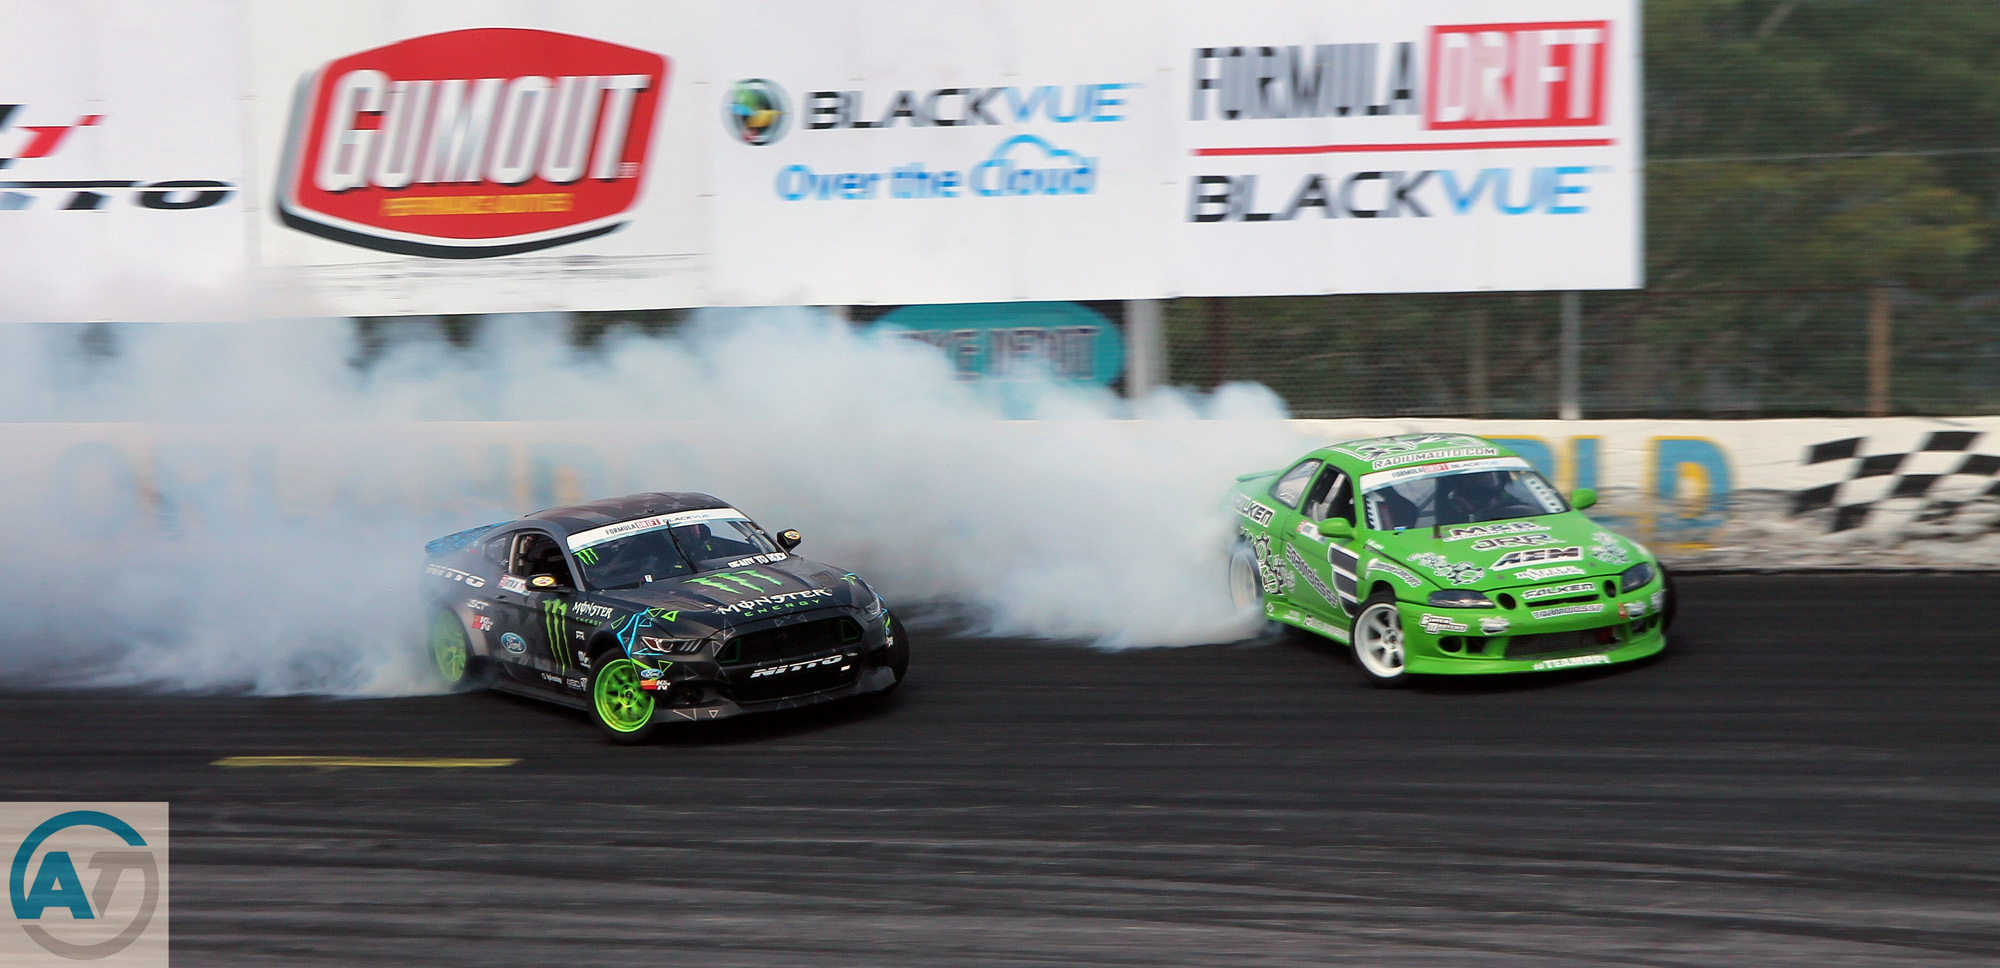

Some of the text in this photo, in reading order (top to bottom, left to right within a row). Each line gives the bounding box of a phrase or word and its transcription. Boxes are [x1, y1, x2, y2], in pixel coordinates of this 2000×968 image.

[1189, 29, 1604, 124] FORMULA DRIFT
[802, 82, 1132, 130] BLACKVUE
[313, 69, 652, 192] GUMOUT
[773, 150, 1099, 201] Over the Cloud
[1186, 166, 1592, 222] BLACKVUE
[1374, 448, 1496, 469] RADIUMAUTO.COM
[1391, 467, 1423, 479] FORMULA
[1422, 462, 1450, 474] DRIFT
[605, 524, 637, 536] FORMULA
[636, 518, 661, 530] DRIFT
[1493, 547, 1580, 568] AEM
[1523, 583, 1595, 598] FALKEN
[572, 601, 614, 619] MONSTER
[716, 588, 833, 615] MONSTER
[744, 599, 821, 617] ENERGY
[575, 617, 603, 626] ENERGY
[750, 654, 843, 679] NITTO
